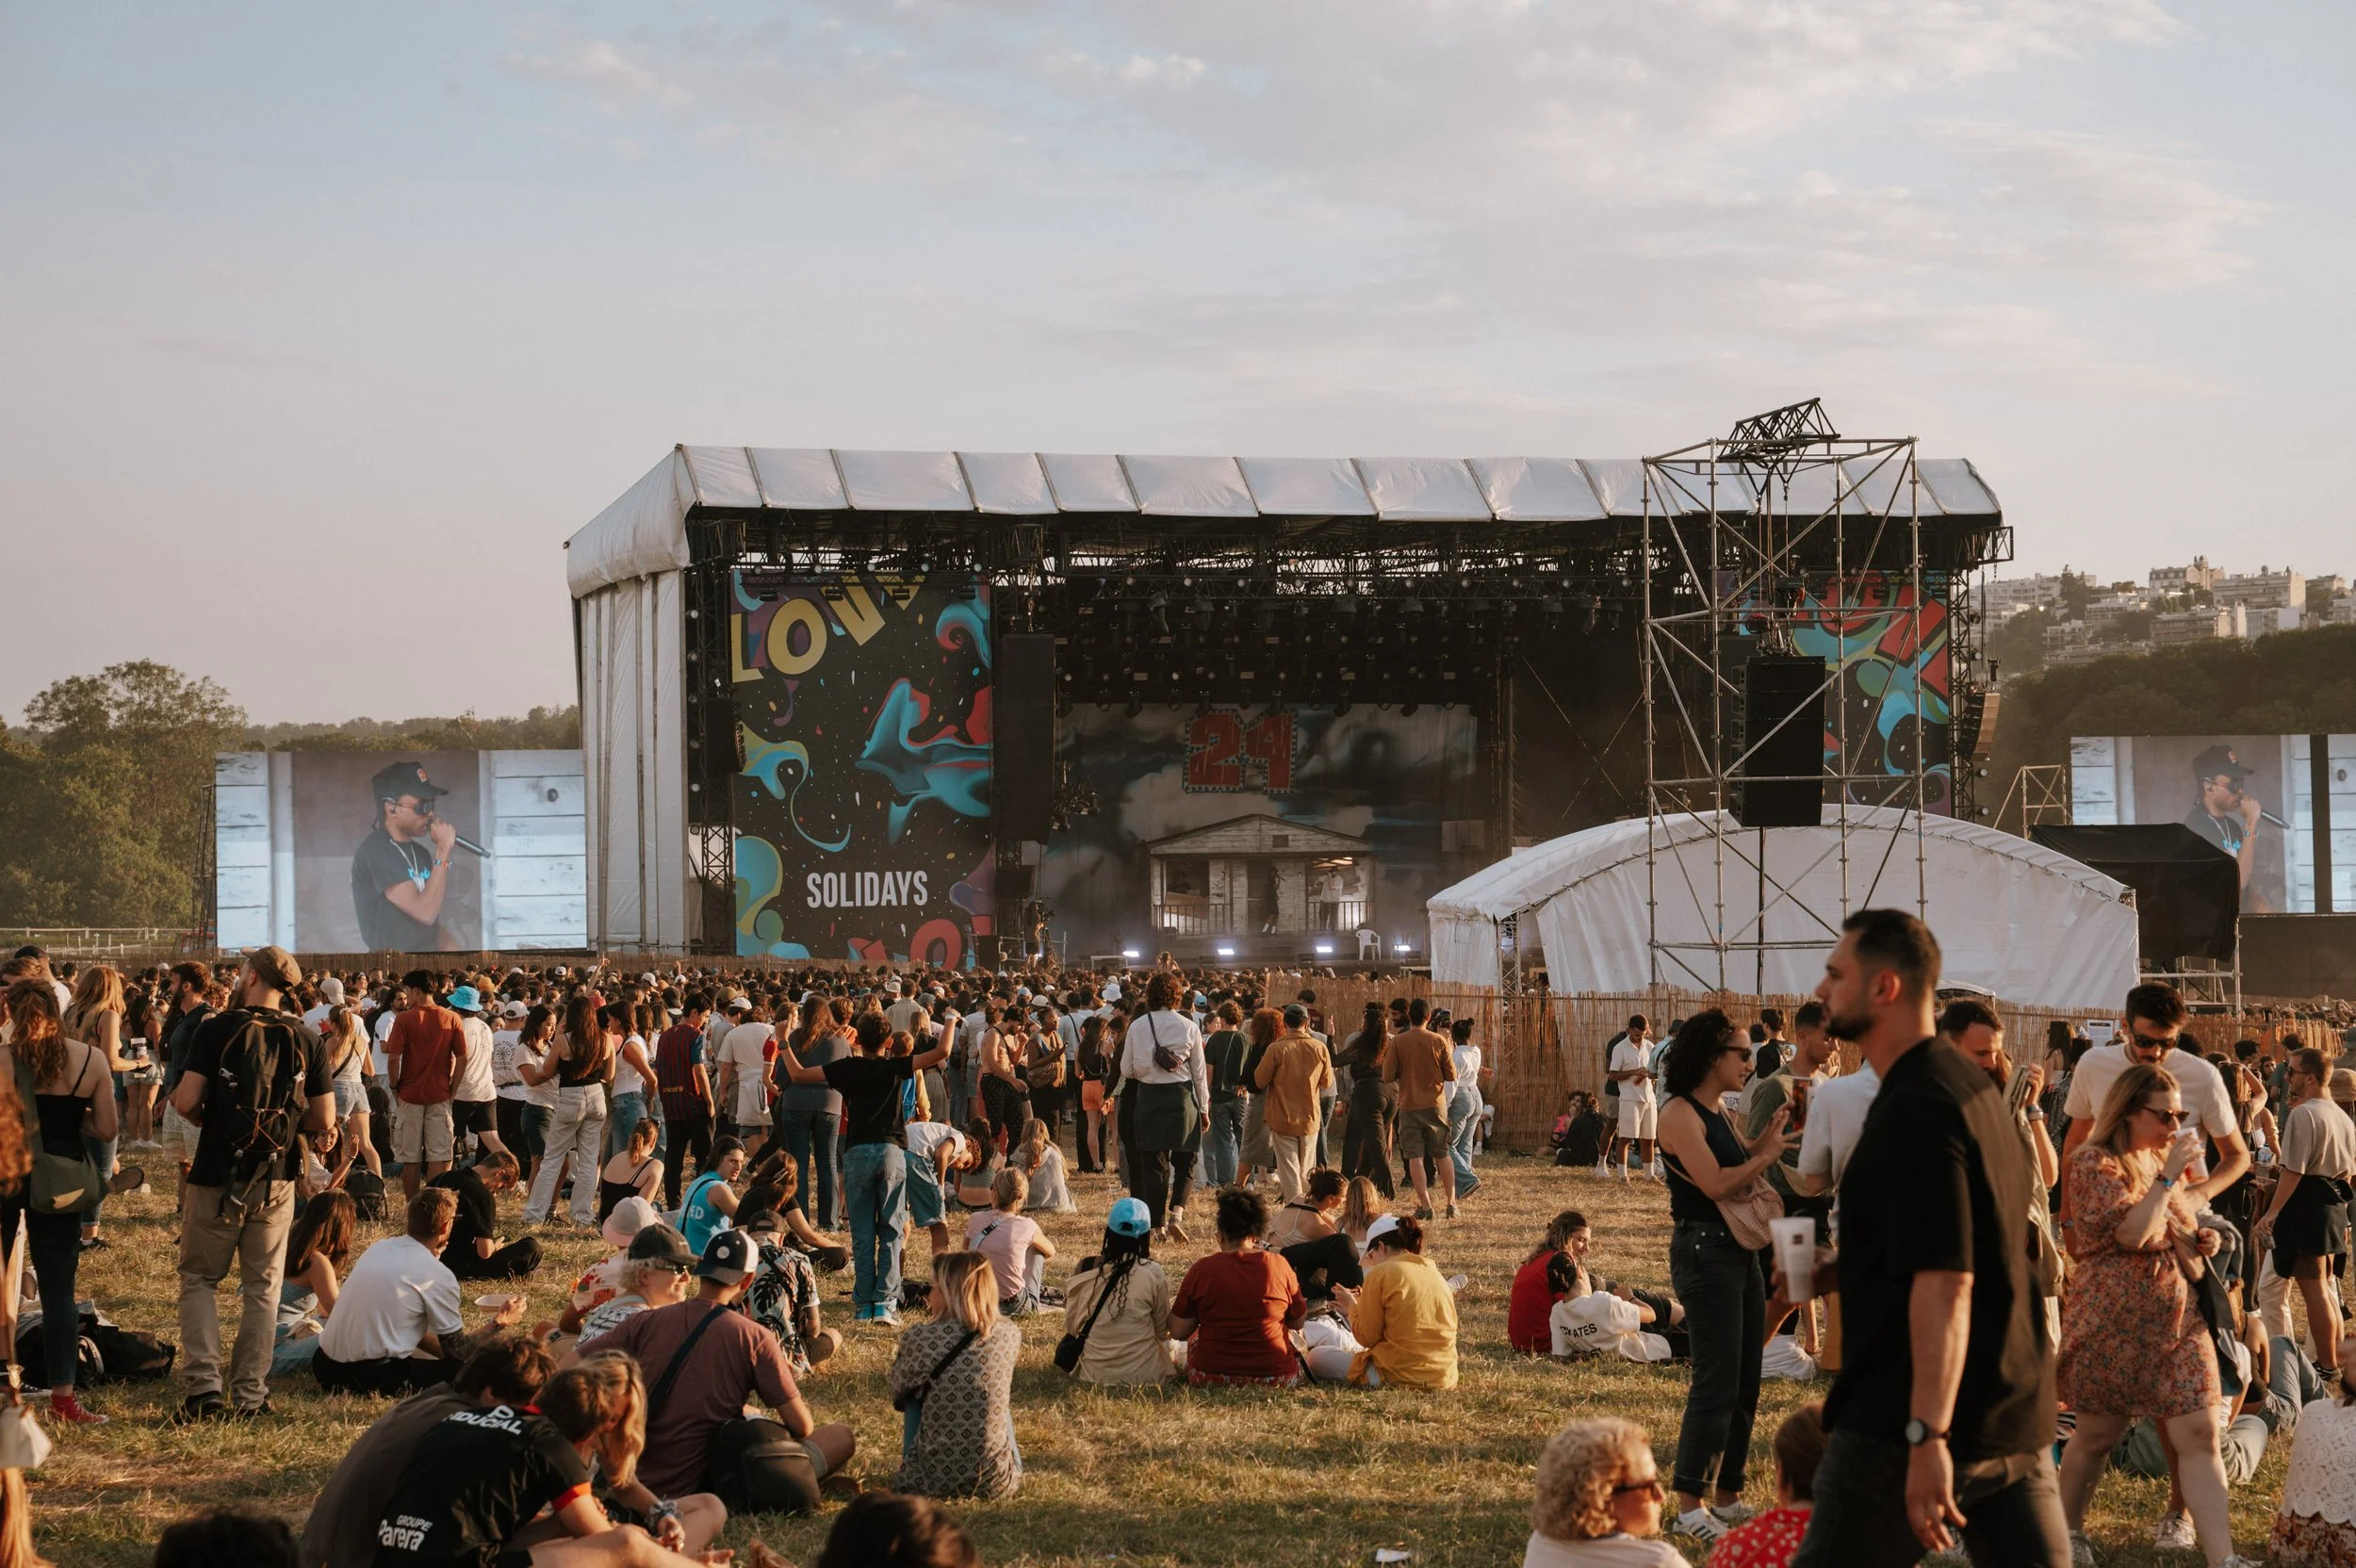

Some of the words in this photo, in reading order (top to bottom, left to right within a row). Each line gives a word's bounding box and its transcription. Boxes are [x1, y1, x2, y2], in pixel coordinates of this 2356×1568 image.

[730, 576, 921, 683] LOV
[1184, 708, 1297, 794] 24
[807, 870, 928, 908] SOLIDAYS
[378, 1519, 425, 1552] Parera
[396, 1514, 434, 1532] GROUPE
